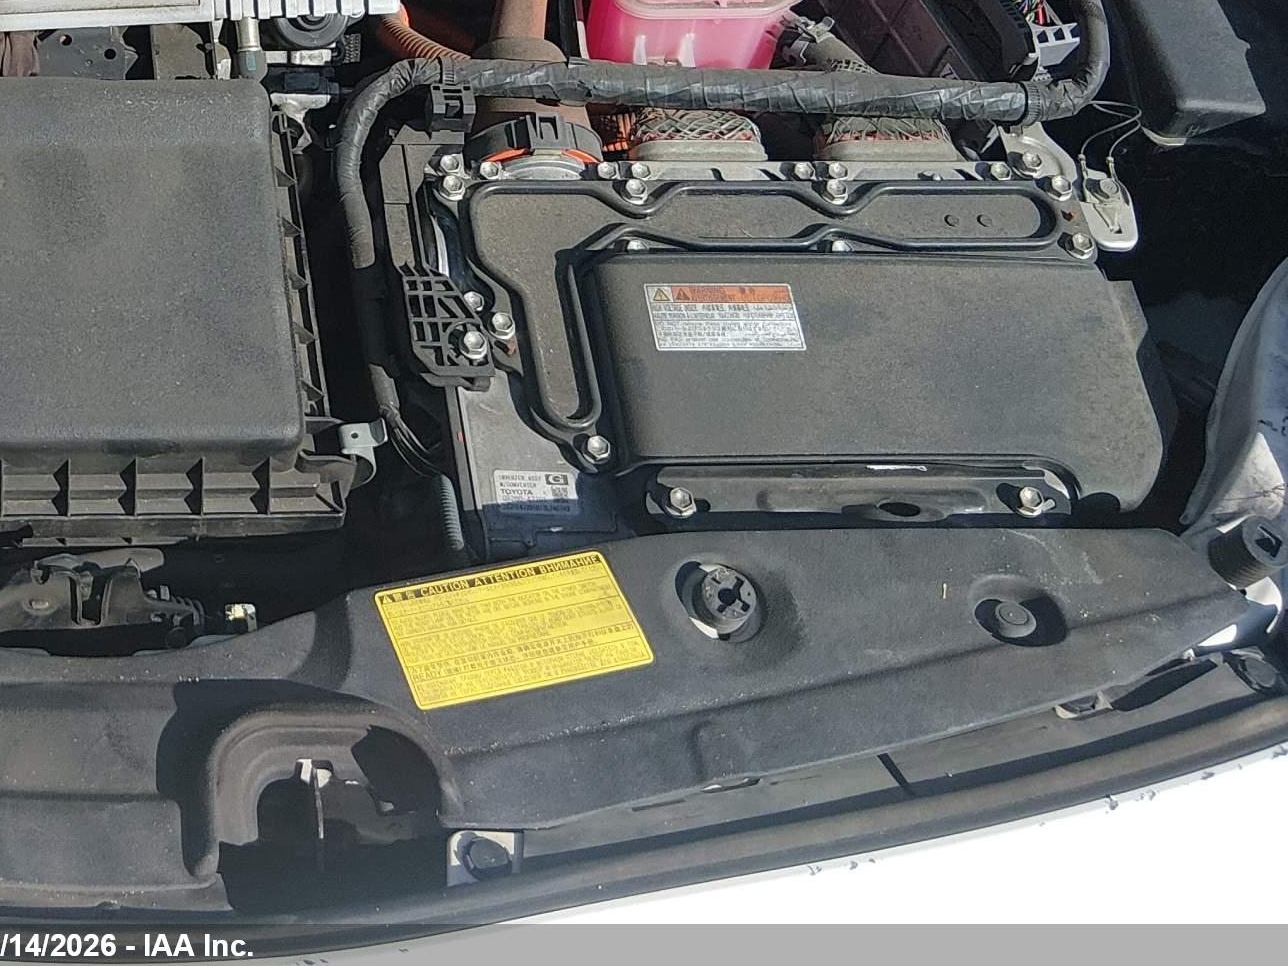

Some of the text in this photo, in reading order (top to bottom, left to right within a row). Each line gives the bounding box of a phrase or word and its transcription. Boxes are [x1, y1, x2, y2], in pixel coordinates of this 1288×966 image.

[420, 580, 469, 596] CAUTION
[474, 567, 536, 587] ATTENTION
[540, 554, 602, 574] ВНИМАНИЕ
